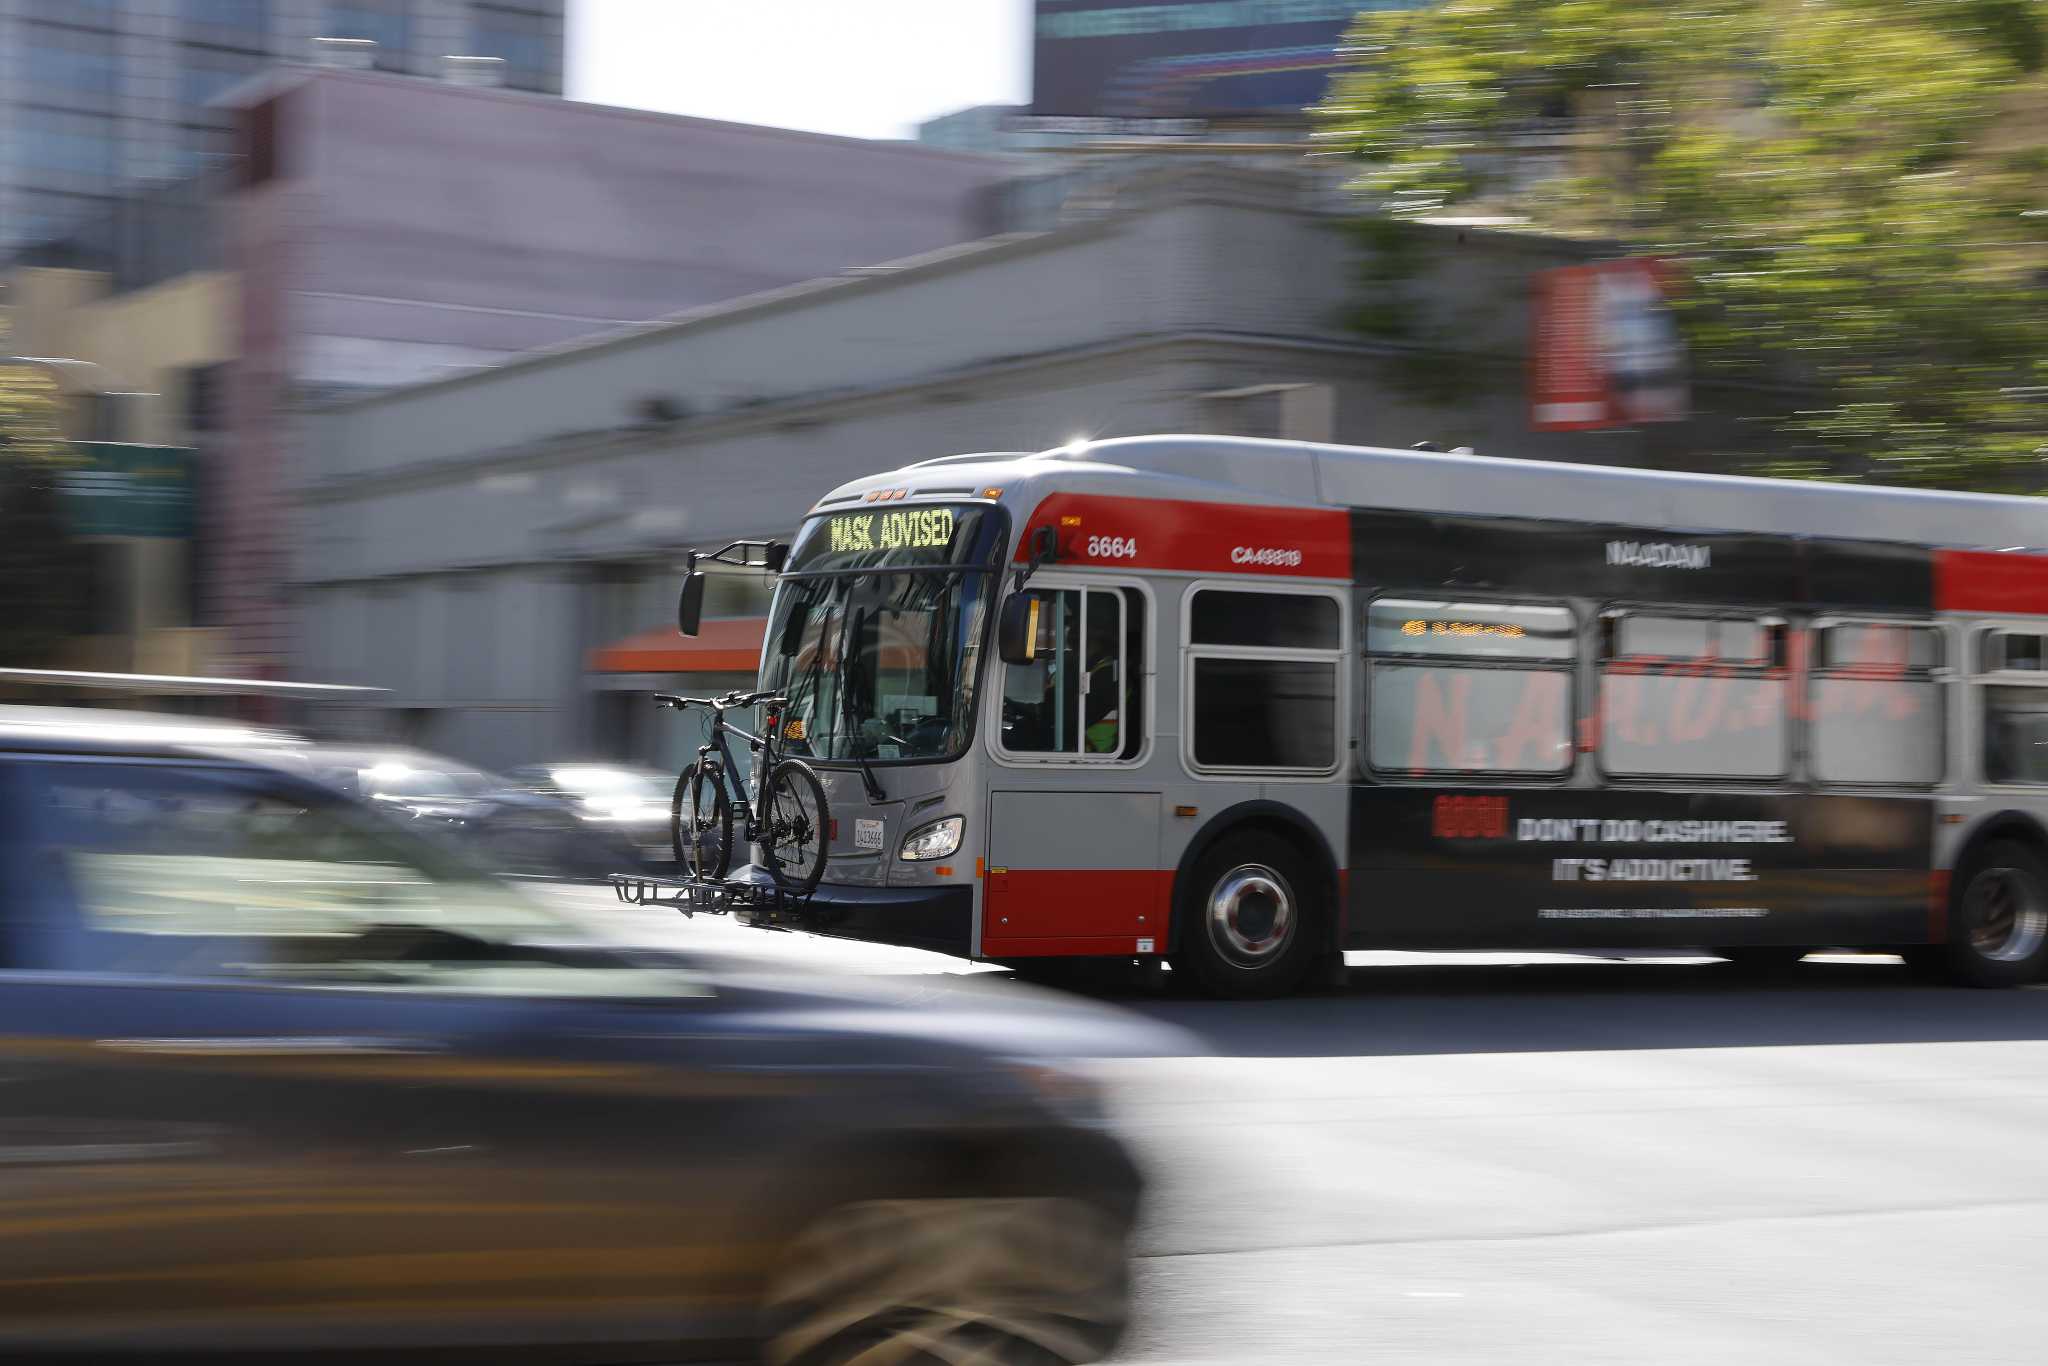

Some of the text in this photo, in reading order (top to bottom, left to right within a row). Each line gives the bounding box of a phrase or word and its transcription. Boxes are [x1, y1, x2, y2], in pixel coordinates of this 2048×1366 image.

[831, 508, 953, 551] MASK ADVISED
[1517, 818, 1796, 842] DON'T DO CASHMERE.
[1552, 858, 1760, 881] IT'S ADDICTIVE.
